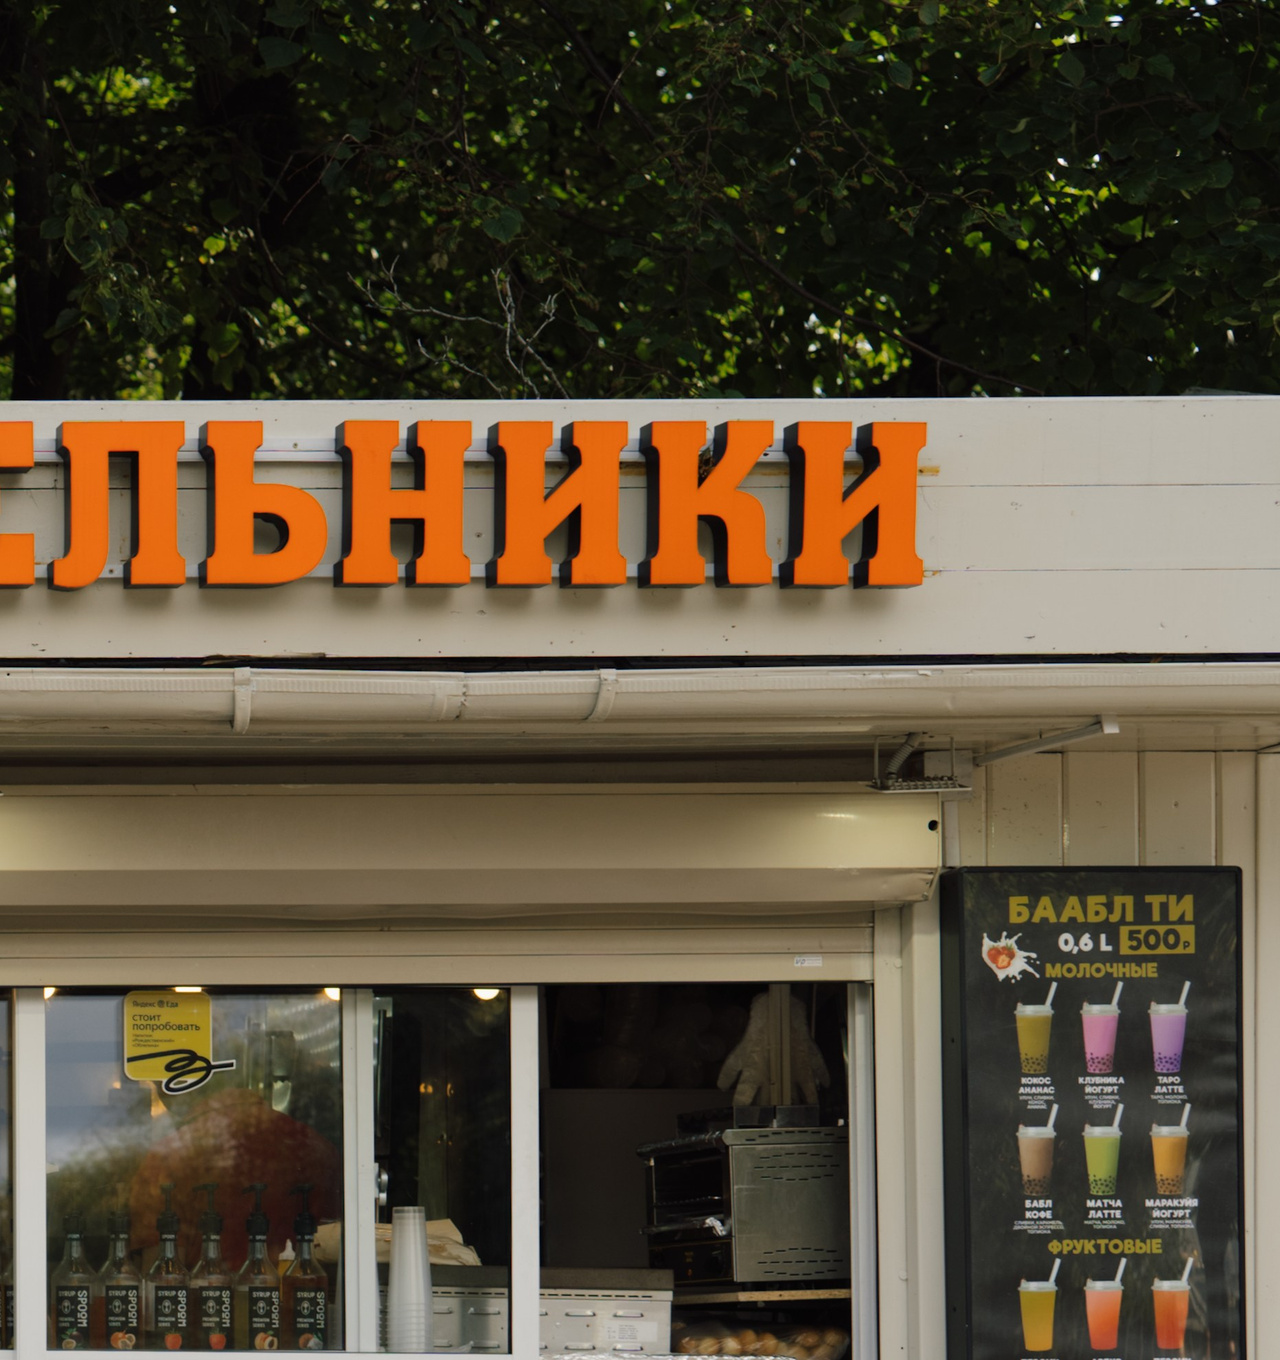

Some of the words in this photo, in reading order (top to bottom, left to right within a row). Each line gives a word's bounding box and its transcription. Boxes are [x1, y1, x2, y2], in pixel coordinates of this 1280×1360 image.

[1009, 895, 1134, 923] БААБЛ
[1145, 894, 1194, 922] ТИ
[1058, 933, 1094, 954] 0,6
[1099, 933, 1113, 951] L
[1045, 962, 1158, 978] МОЛОЧНЫЕ
[132, 1022, 200, 1032] попробовать
[1021, 1076, 1051, 1085] КОКОС
[1078, 1076, 1125, 1084] КЛУБНИКА
[1157, 1076, 1180, 1084] ТАРО
[1018, 1086, 1055, 1094] АНАНАС
[1084, 1084, 1119, 1093] ЙОГУРТ
[1154, 1085, 1184, 1093] ЛАТТЕ
[1025, 1200, 1052, 1208] БАБЛ
[1086, 1199, 1122, 1208] МАТЧА
[1145, 1197, 1198, 1207] МАРАКУЙЯ
[1025, 1210, 1052, 1219] КОФЕ
[1088, 1210, 1122, 1218] ЛАТТЕ
[1152, 1208, 1191, 1218] ЙОГУРТ
[1047, 1239, 1163, 1254] ФРУКТОВЫЕ
